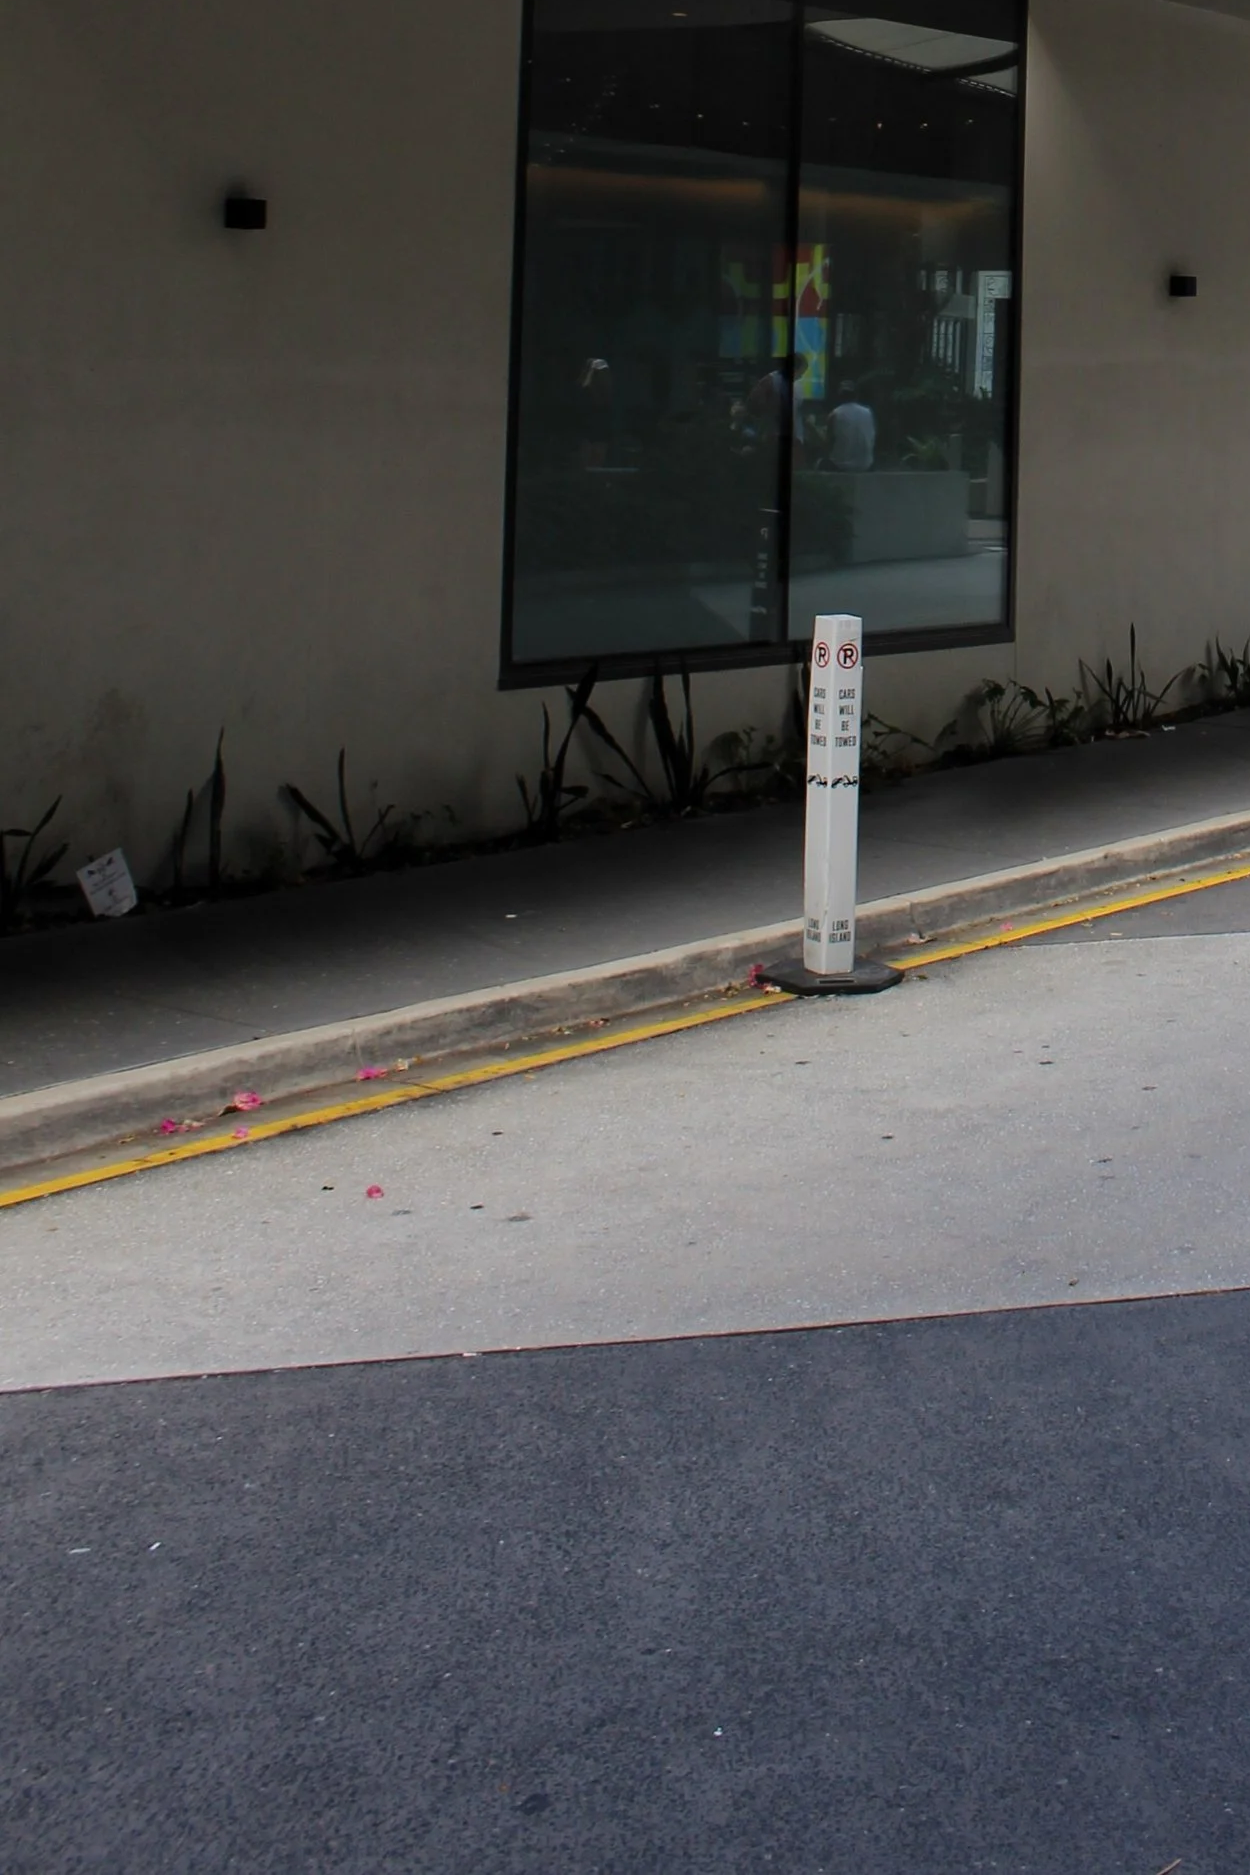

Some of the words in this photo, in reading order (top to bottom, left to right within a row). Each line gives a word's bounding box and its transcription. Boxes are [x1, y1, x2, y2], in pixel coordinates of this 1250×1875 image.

[814, 686, 826, 699] CARS
[839, 688, 856, 700] CARS
[839, 705, 854, 715] WILL
[841, 720, 850, 731] BE
[835, 735, 857, 747] TOWED
[832, 919, 849, 931] LONG
